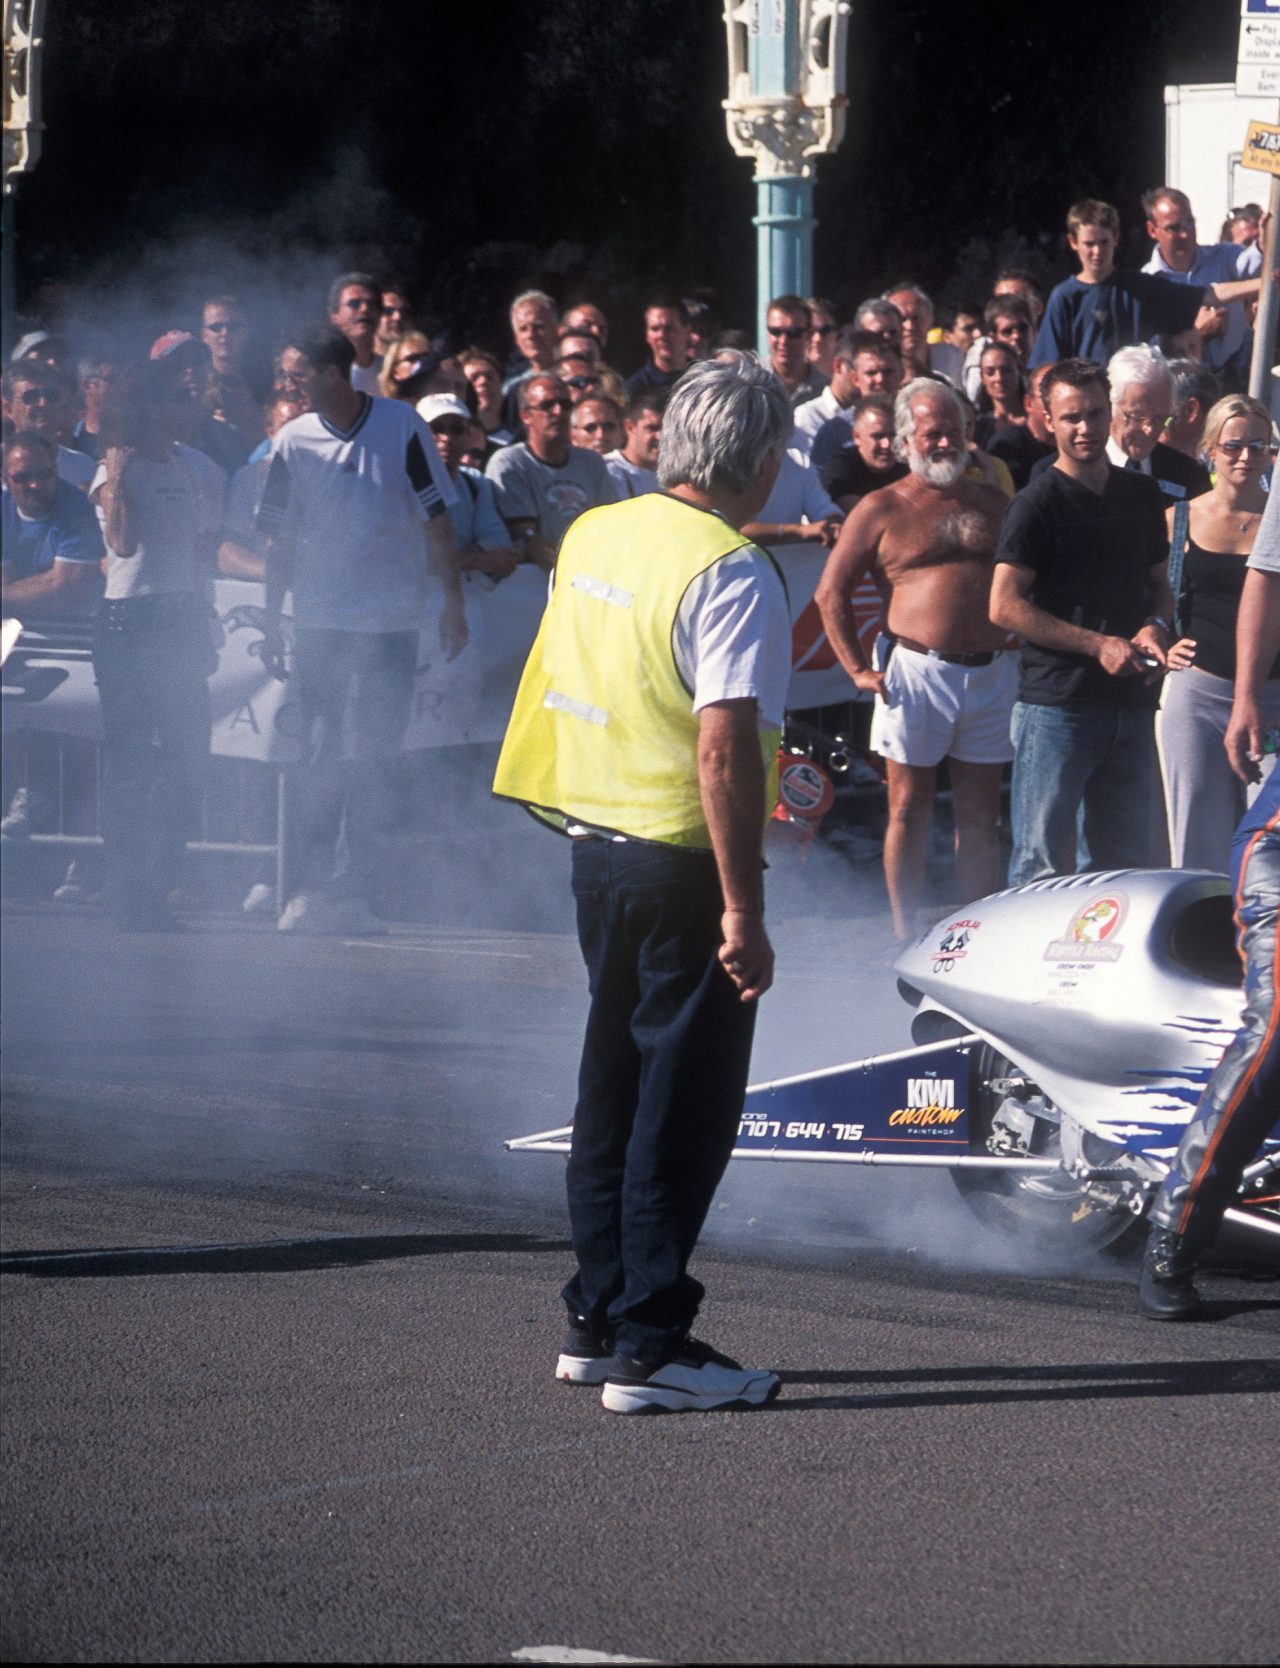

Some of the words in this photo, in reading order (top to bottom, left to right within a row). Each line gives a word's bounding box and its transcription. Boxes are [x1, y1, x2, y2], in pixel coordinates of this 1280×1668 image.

[1262, 24, 1277, 36] Pay
[907, 1078, 955, 1108] KIWI
[888, 1098, 965, 1127] custom
[736, 1120, 781, 1138] 1707
[831, 1123, 865, 1141] 715
[907, 1128, 955, 1136] PAINTSHOP
